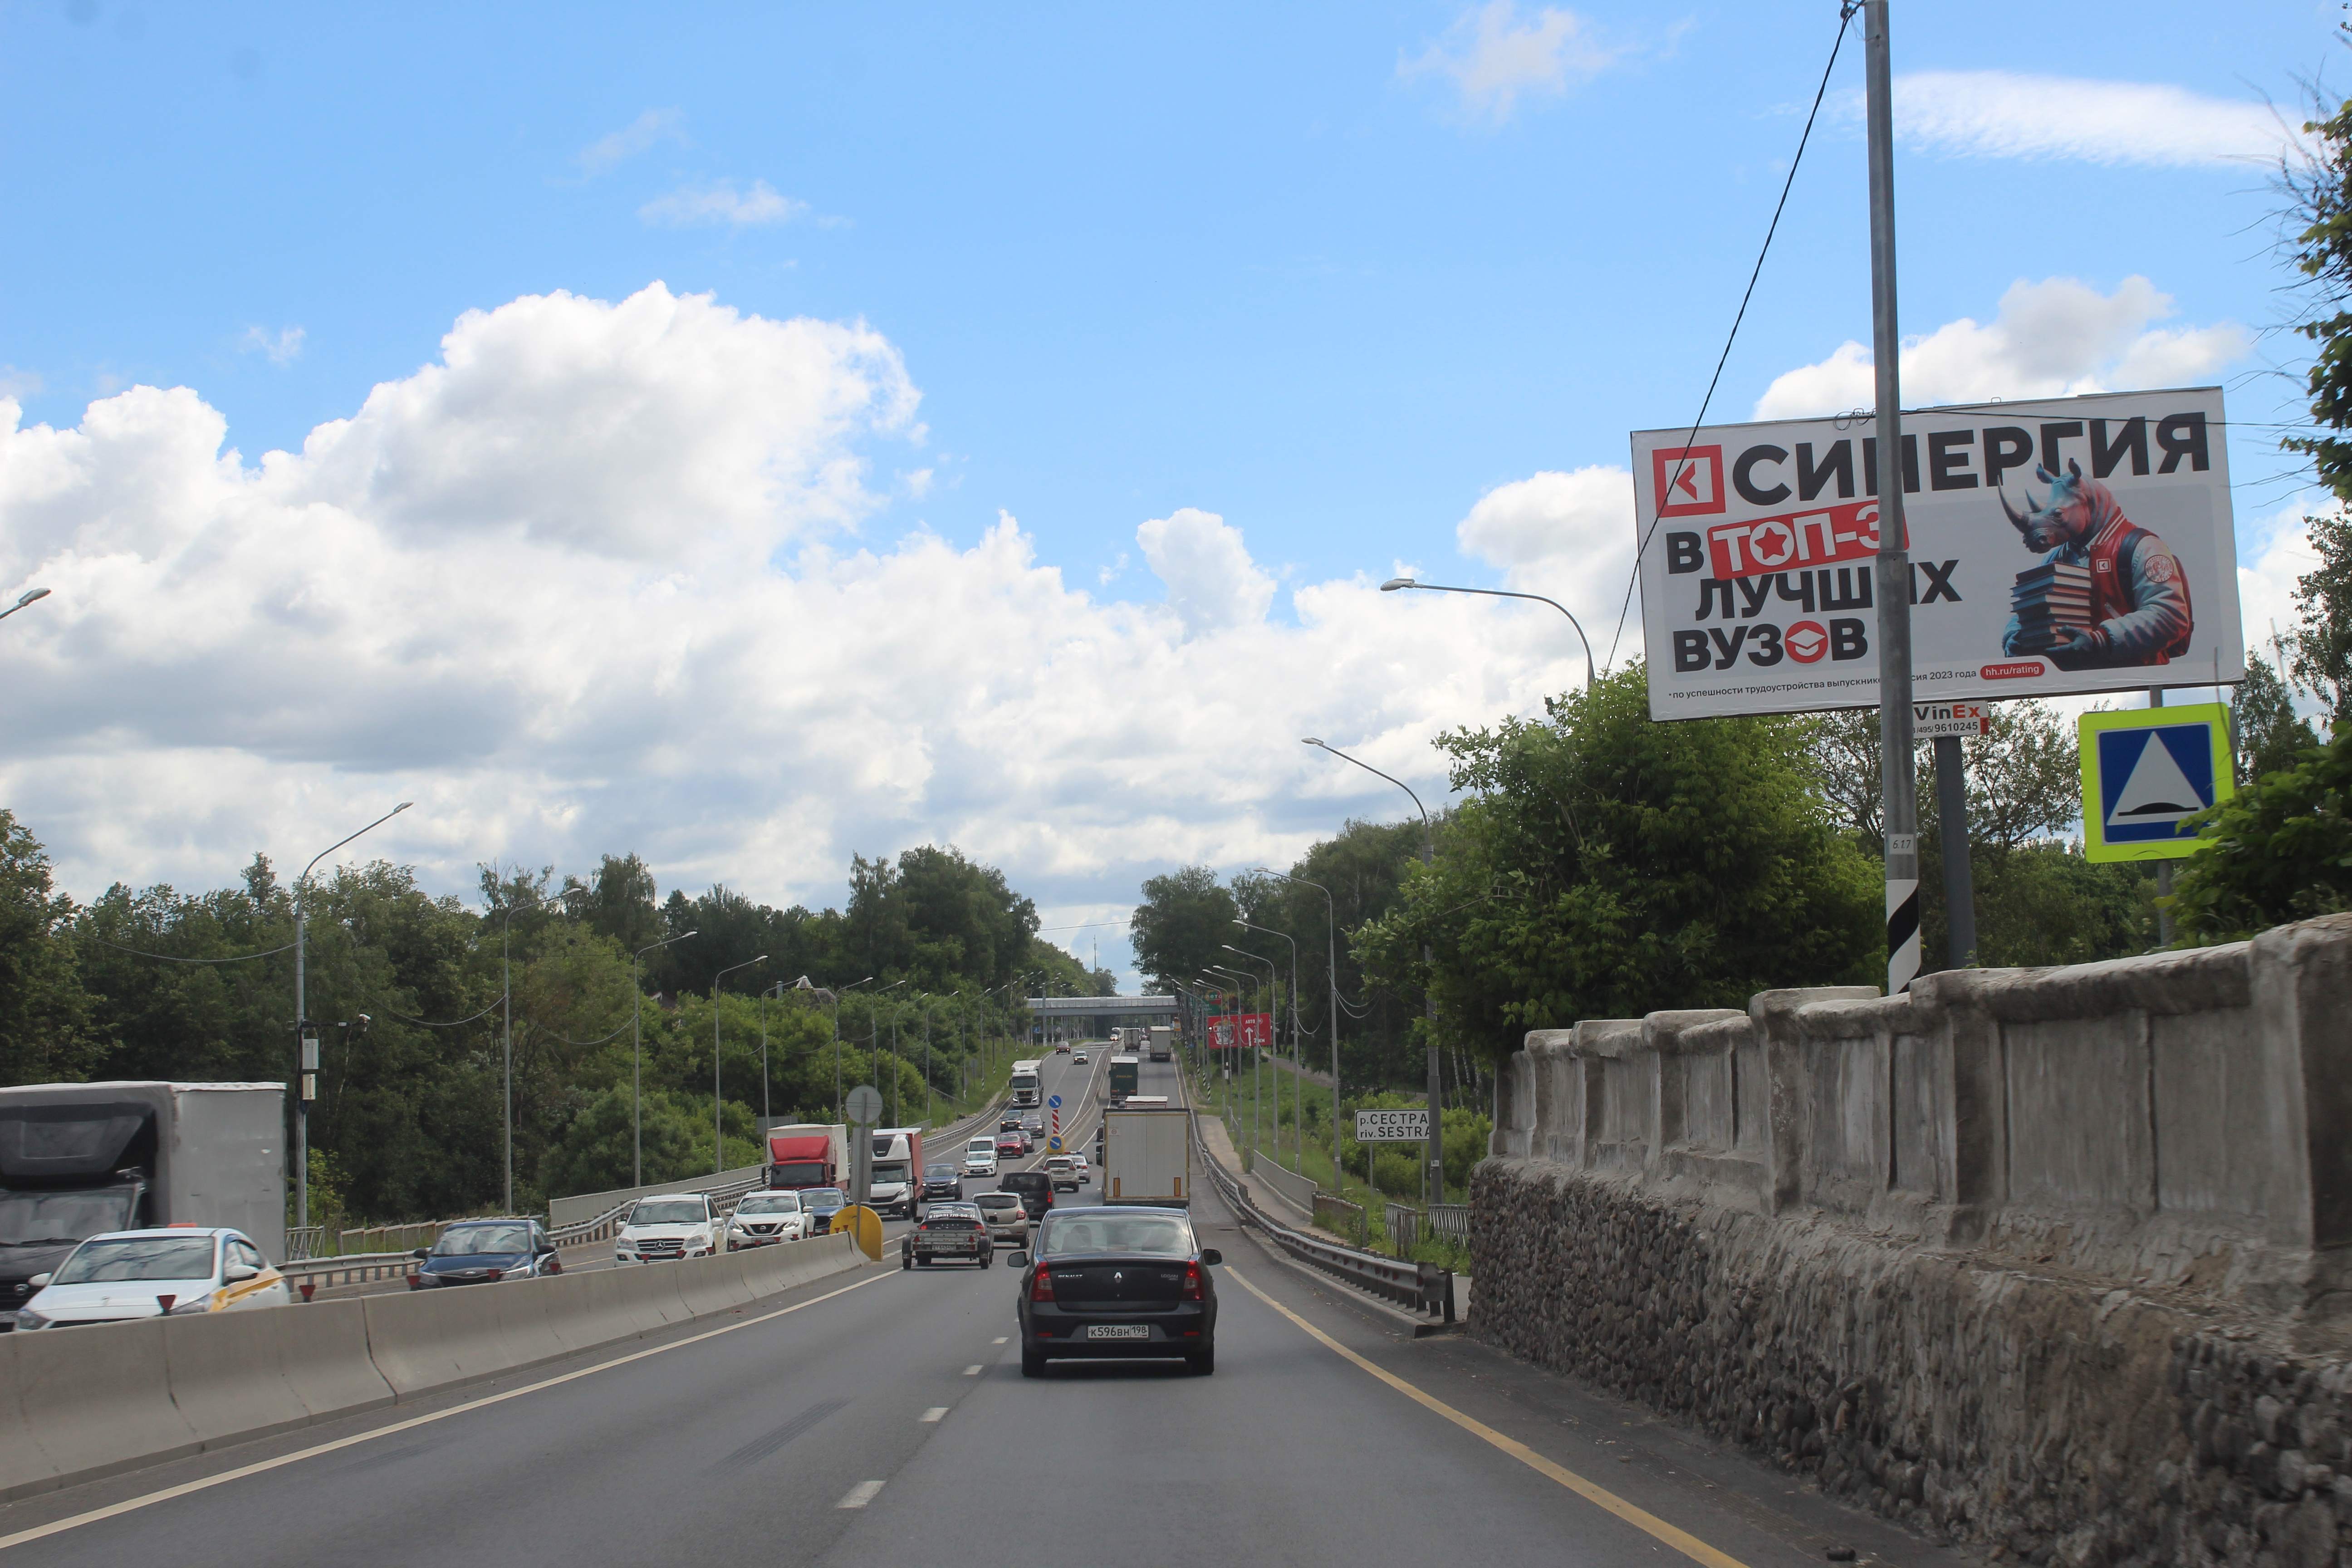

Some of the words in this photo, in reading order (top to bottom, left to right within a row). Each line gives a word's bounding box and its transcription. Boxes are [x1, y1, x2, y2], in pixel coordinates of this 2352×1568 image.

[1732, 411, 2210, 506] СИНЕРГИЯ
[1666, 531, 1704, 574] В
[1695, 559, 1962, 621] ЛУЧШХ
[1686, 686, 1743, 699] успешности
[1745, 681, 1825, 694] трудоустройства
[1930, 671, 1953, 680] 2023
[1955, 670, 1976, 679] года
[1986, 665, 2039, 676] hh.ru/rating
[1914, 705, 1980, 720] VinEx
[1370, 1113, 1428, 1124] СЕСТРА
